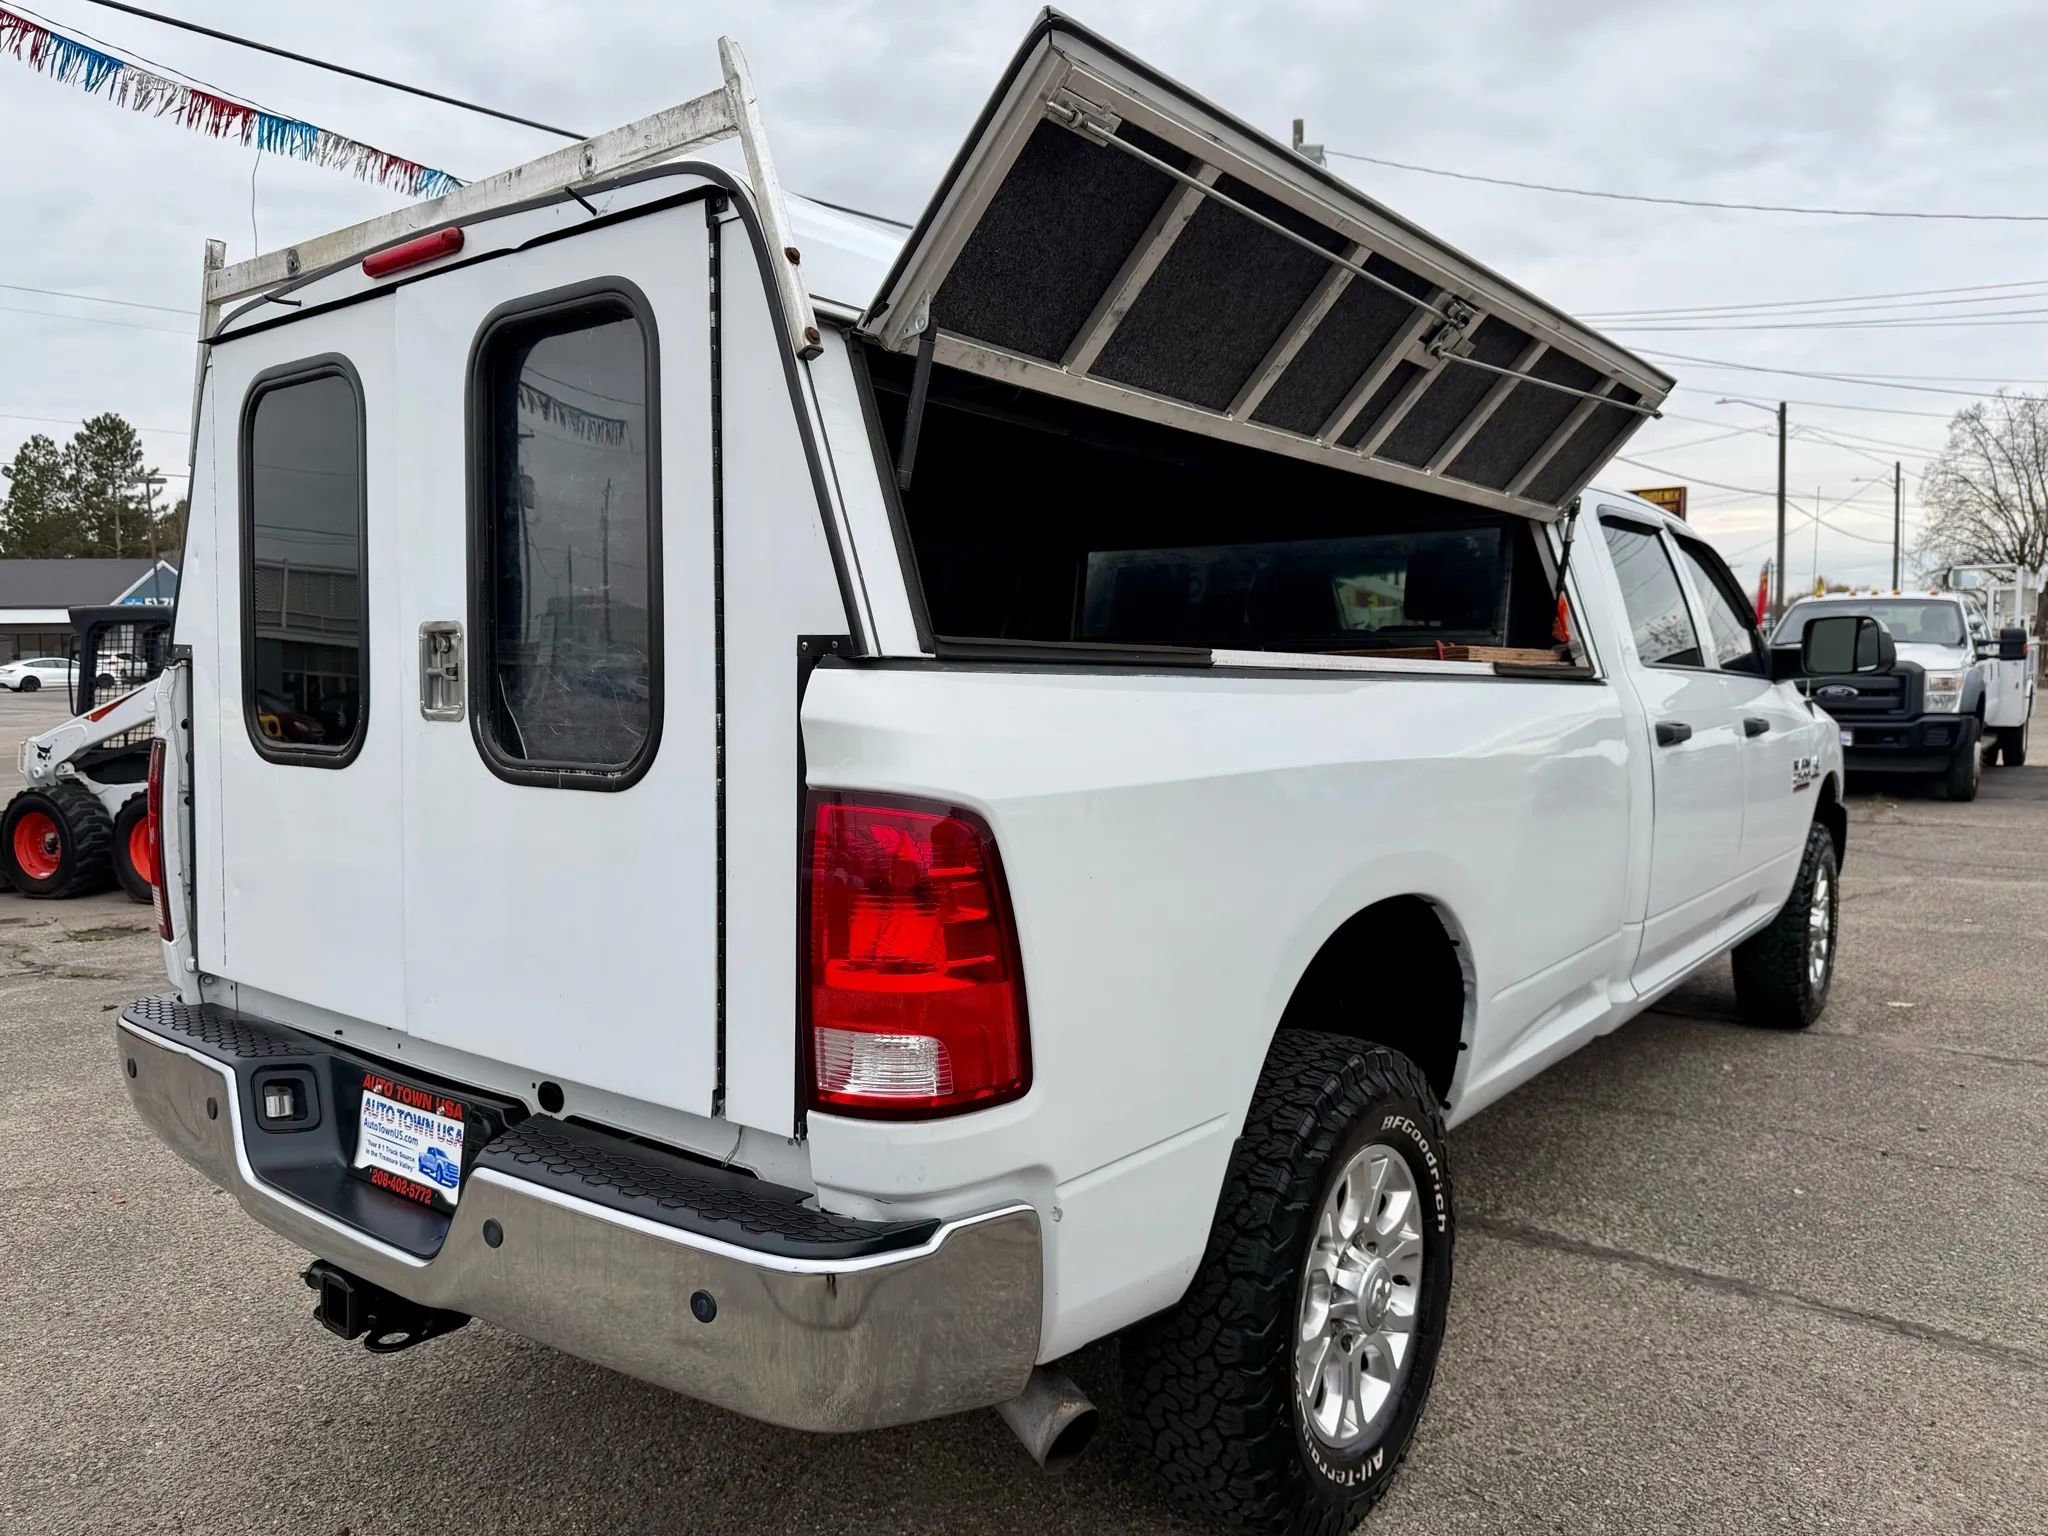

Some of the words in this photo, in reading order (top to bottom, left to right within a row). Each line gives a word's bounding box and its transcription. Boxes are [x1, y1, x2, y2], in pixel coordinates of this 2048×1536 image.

[363, 1074, 393, 1097] AUTO
[396, 1085, 432, 1110] TOWN
[435, 1097, 463, 1120] USA
[363, 1098, 395, 1124] AUTO
[397, 1108, 434, 1139] TOWN
[437, 1122, 464, 1149] USA
[363, 1118, 419, 1147] AutoTownUS.com
[386, 1146, 398, 1156] Truck
[371, 1168, 432, 1206] 208-402-5772
[1380, 1115, 1447, 1232] BFGoodrich
